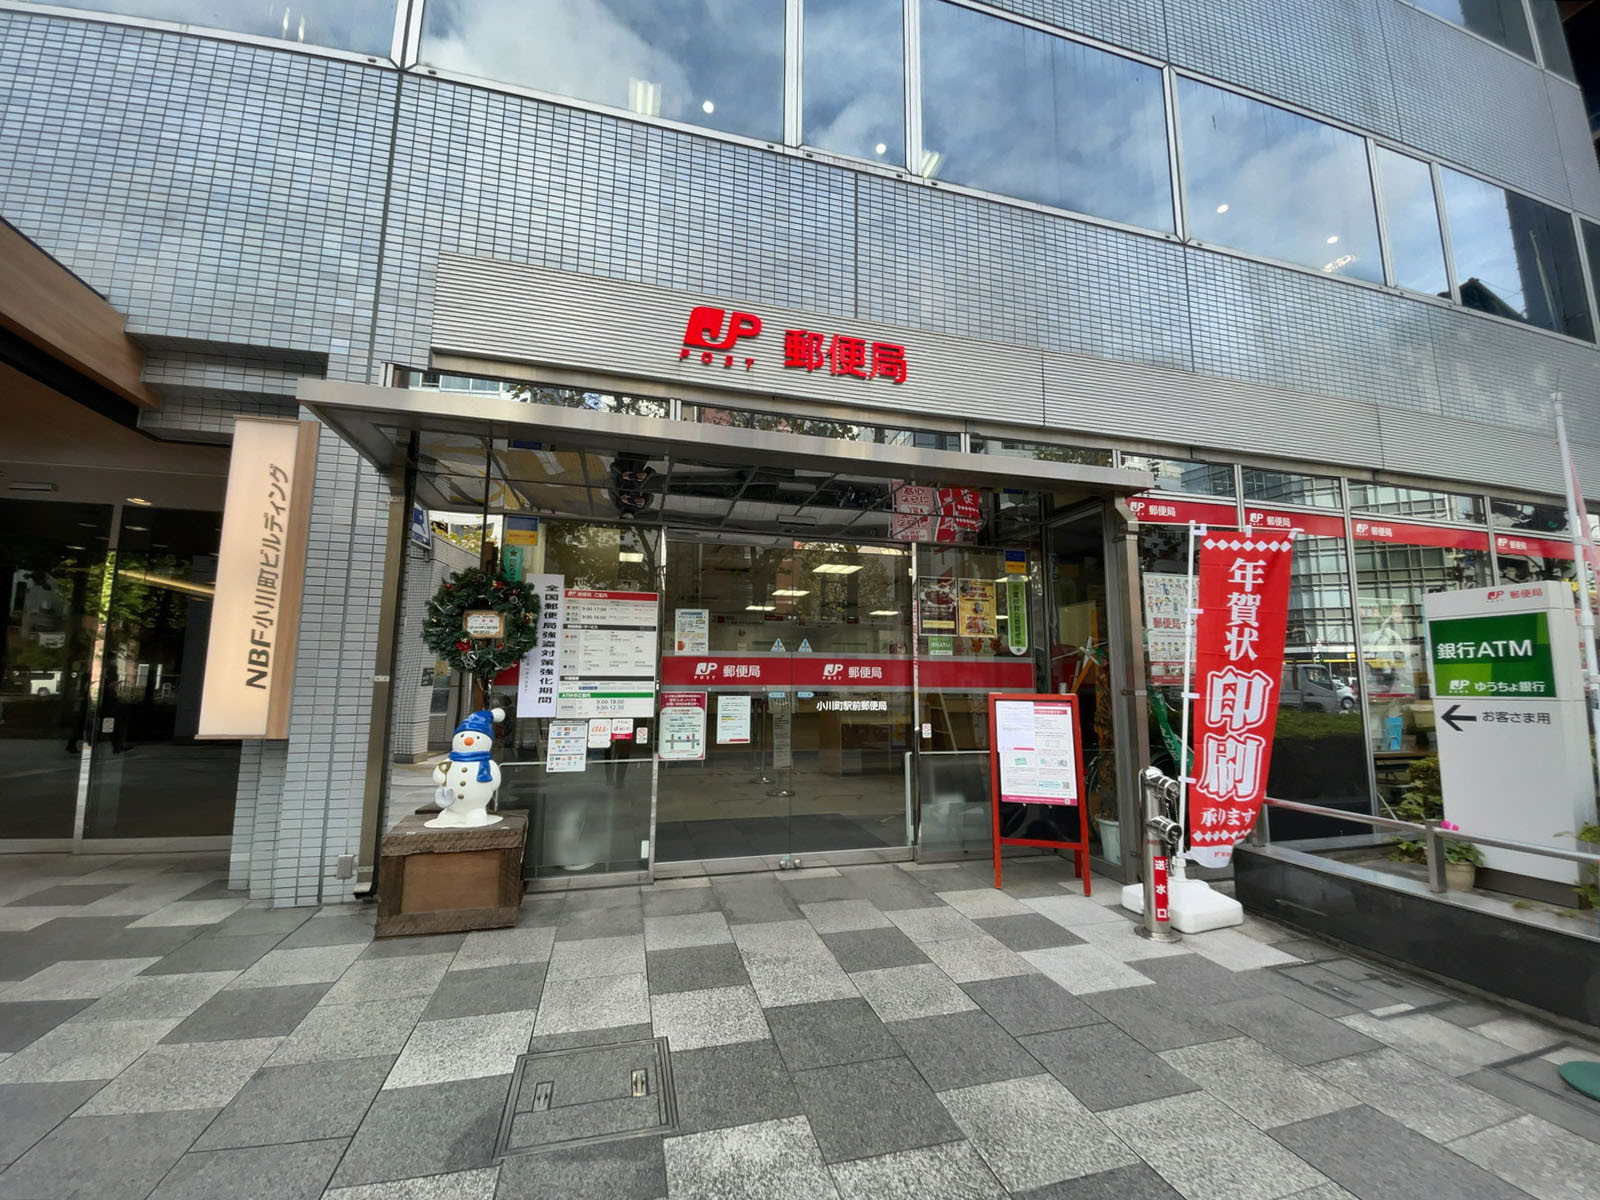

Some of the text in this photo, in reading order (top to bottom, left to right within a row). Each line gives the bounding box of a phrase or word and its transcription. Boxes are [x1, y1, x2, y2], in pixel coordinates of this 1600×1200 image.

[683, 306, 907, 383] JP 郵便局
[680, 348, 755, 370] POST
[1149, 505, 1176, 517] 郵便局
[1267, 516, 1291, 527] 郵便局
[1371, 526, 1392, 538] 郵便局
[245, 463, 289, 689] NBF小川町ビルディング
[1509, 588, 1543, 599] 郵便局
[1224, 558, 1267, 661] 年賀状
[537, 584, 559, 704] 全国郵便局強盗対策強化期間
[1436, 639, 1533, 660] 銀行ATM
[723, 665, 761, 678] 郵便局
[848, 666, 883, 679] 郵便局
[1474, 680, 1546, 692] ゆうちょ銀行
[816, 700, 888, 711] 小川町駅前郵便局
[1482, 711, 1551, 725] お客さま用
[1197, 666, 1273, 801] 印刷
[1200, 808, 1257, 826] 承ります
[1154, 859, 1167, 918] 送水口
